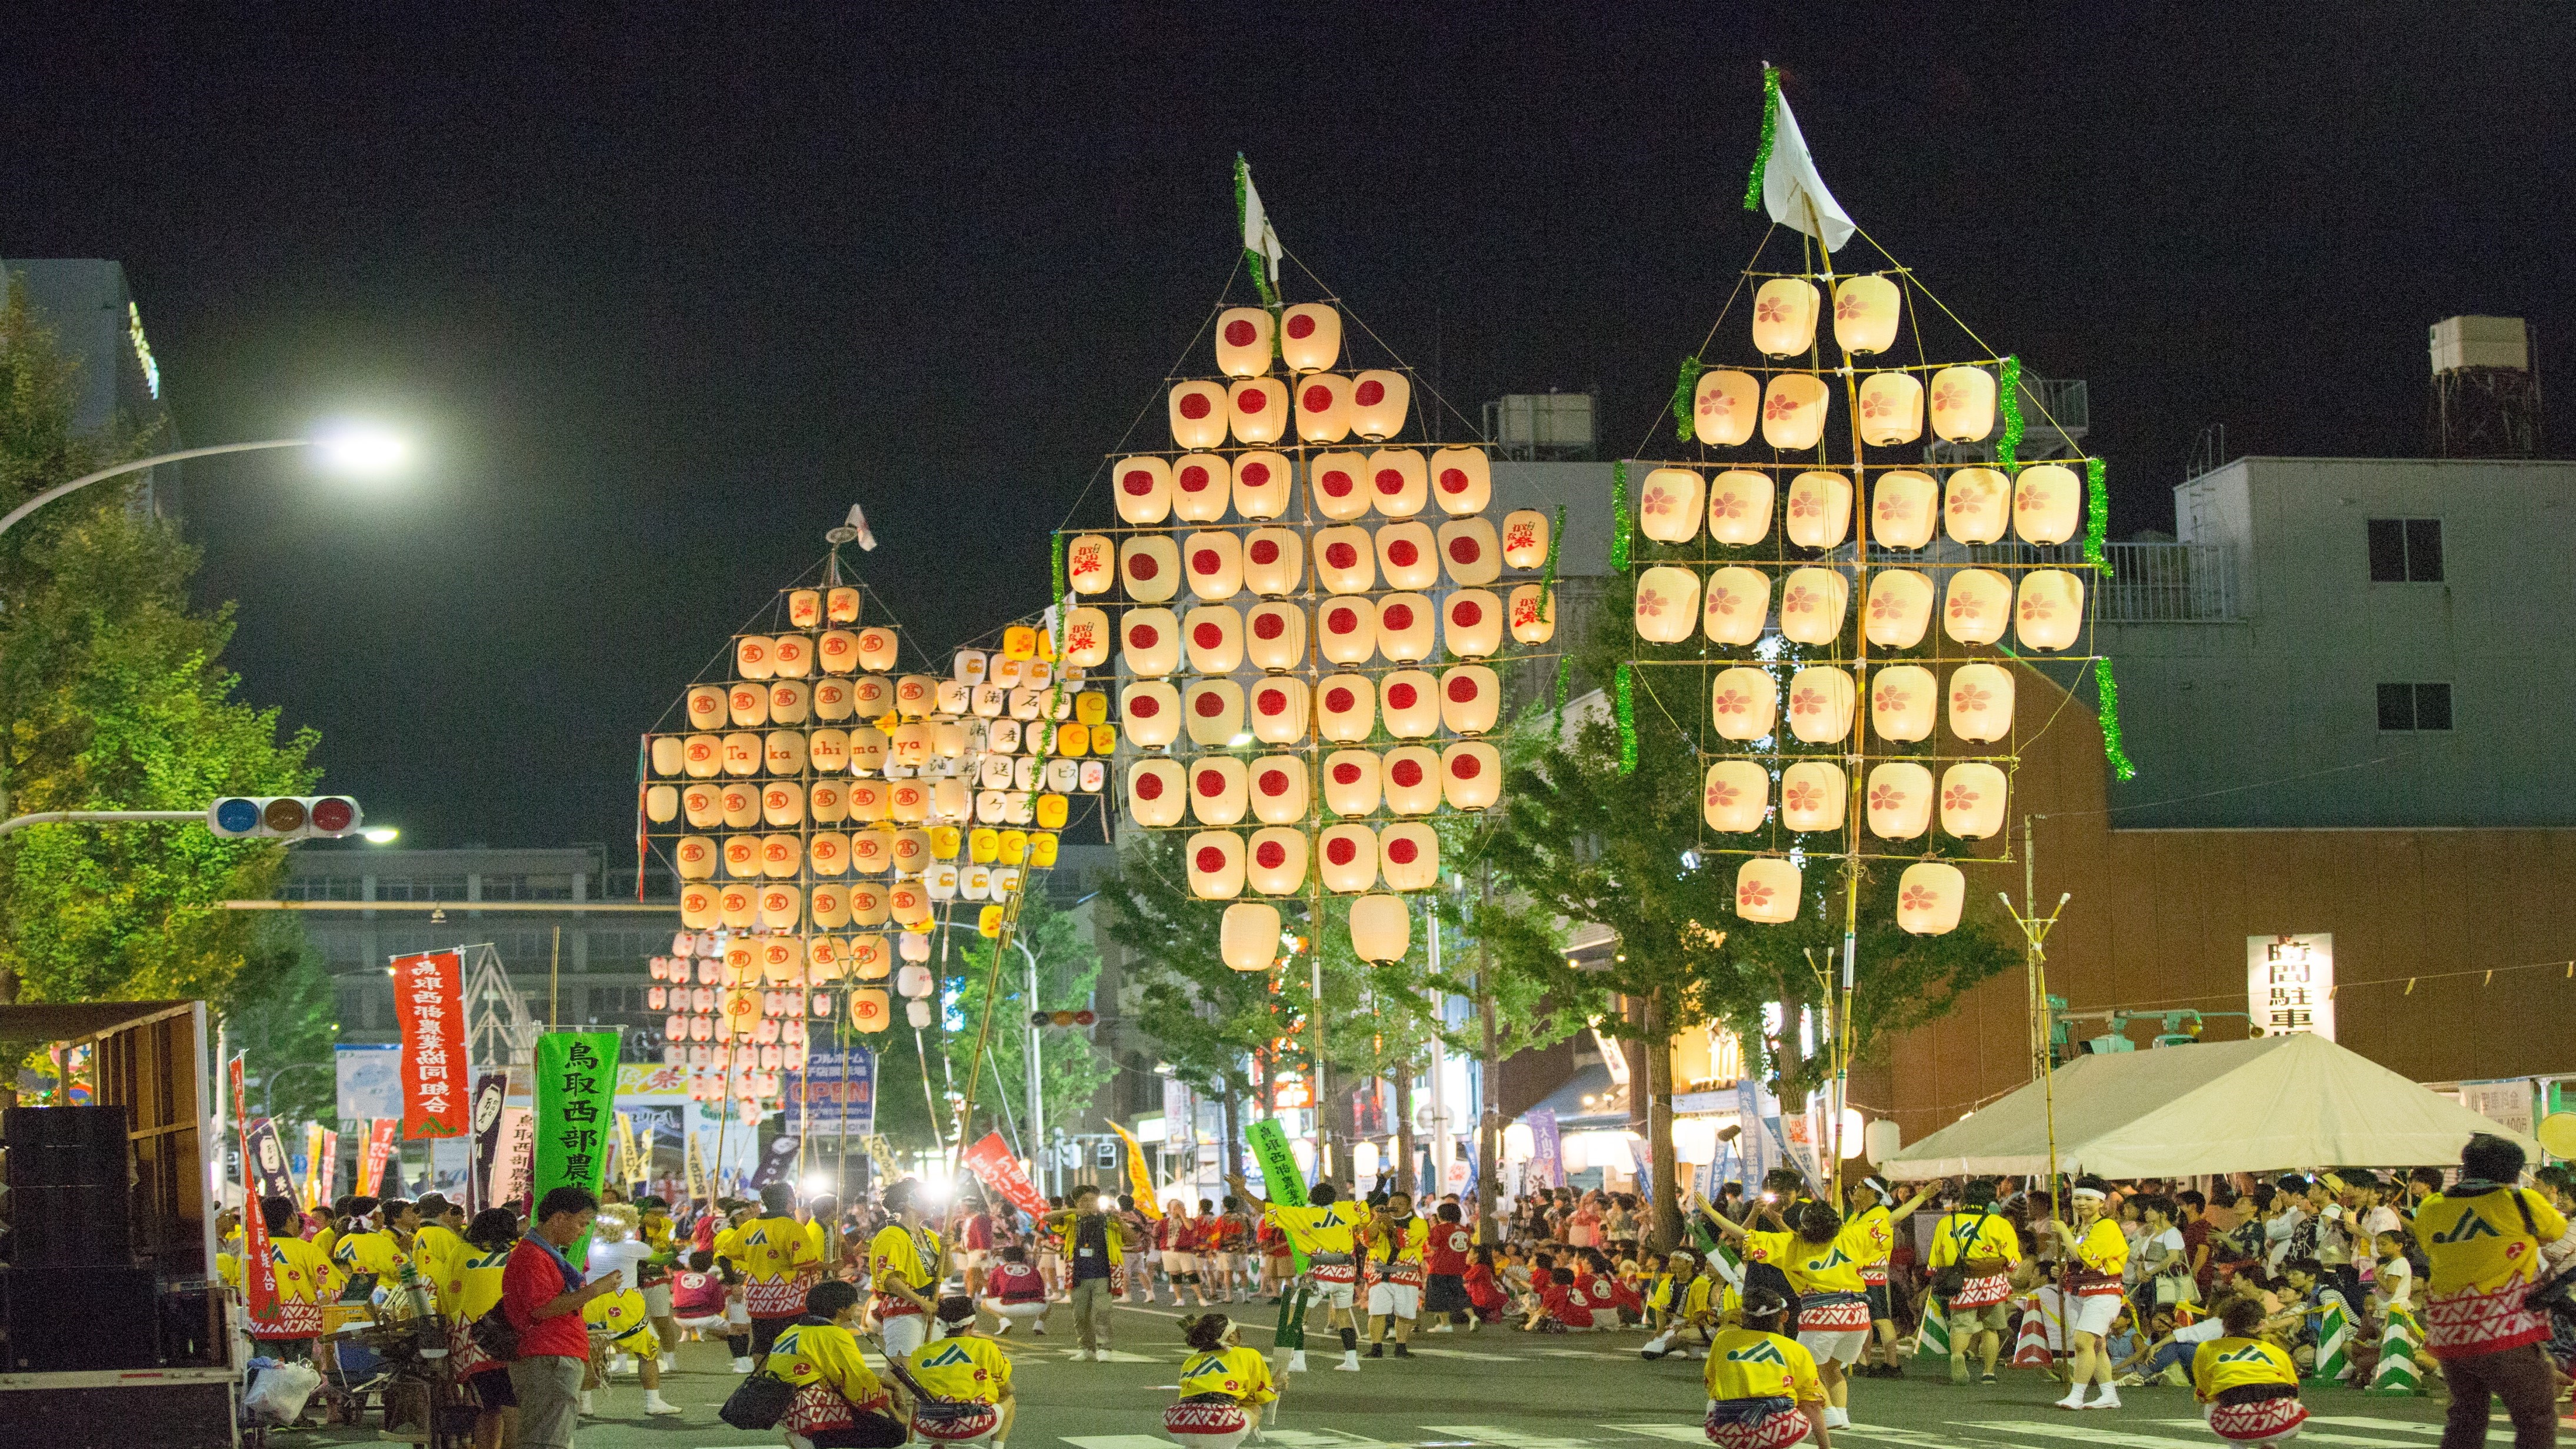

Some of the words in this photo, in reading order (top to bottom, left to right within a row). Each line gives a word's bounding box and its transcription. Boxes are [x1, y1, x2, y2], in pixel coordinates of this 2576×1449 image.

[726, 745, 747, 760] Ta
[769, 745, 791, 760] ka
[814, 741, 840, 755] shi
[853, 744, 879, 754] ma
[897, 740, 921, 756] ya
[790, 1081, 869, 1103] OPEN
